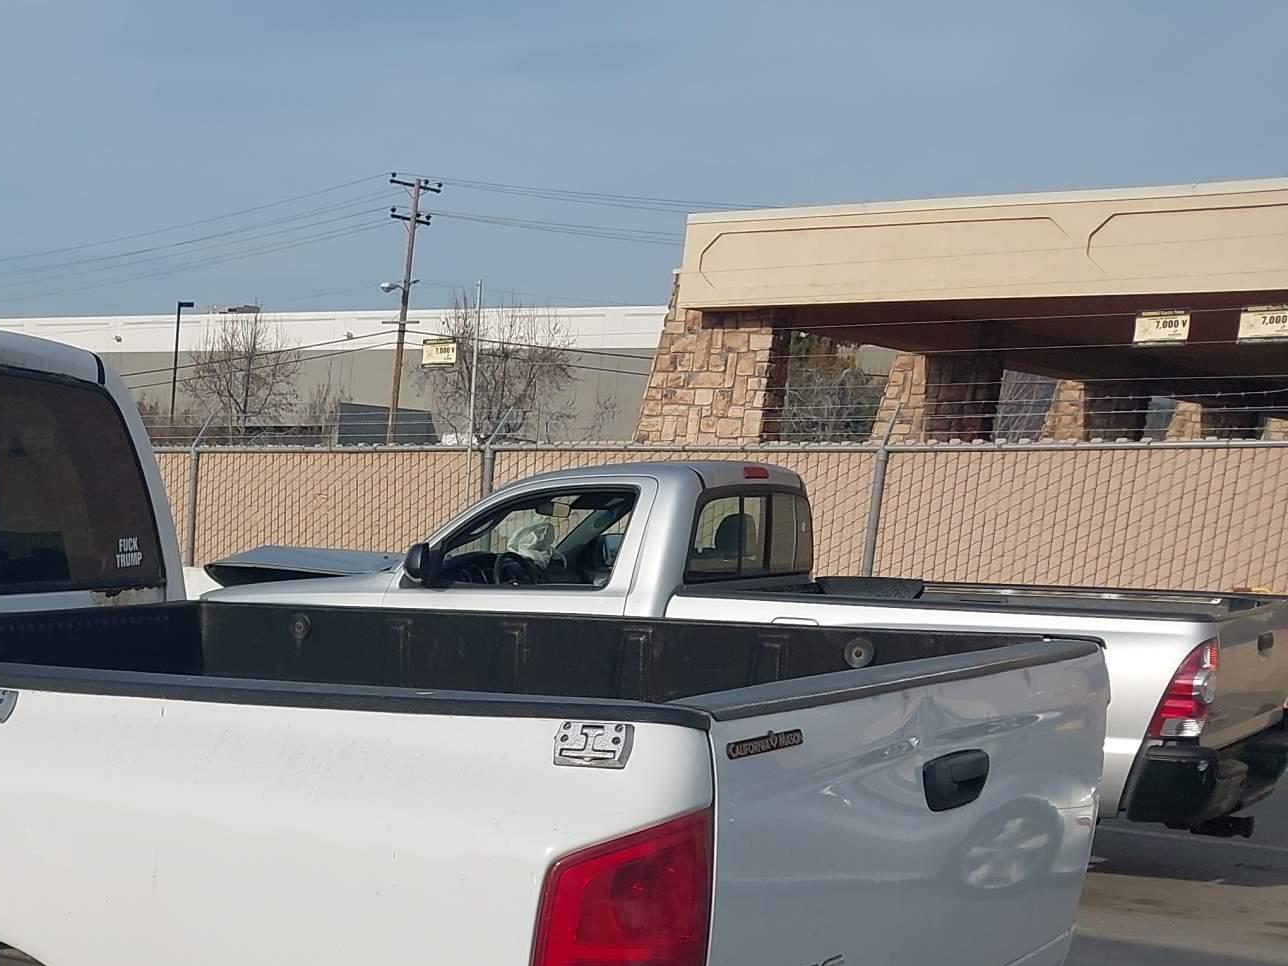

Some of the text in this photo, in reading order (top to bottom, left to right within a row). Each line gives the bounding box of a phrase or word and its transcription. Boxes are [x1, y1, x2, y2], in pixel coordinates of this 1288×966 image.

[1155, 320, 1188, 330] 7,000 V
[1261, 314, 1287, 326] 7,000
[118, 537, 138, 552] FUCK
[116, 552, 142, 568] TRUMP
